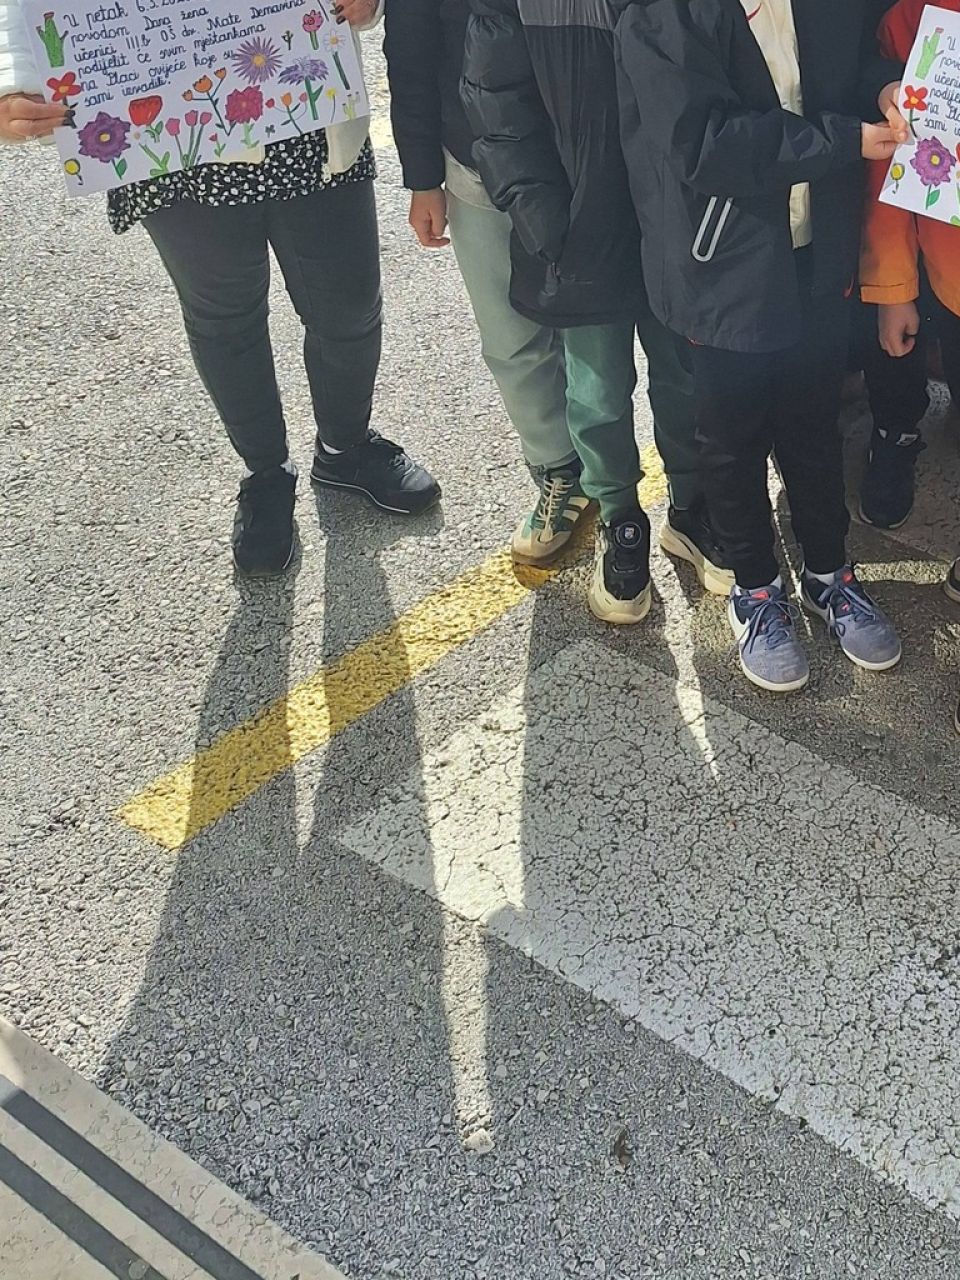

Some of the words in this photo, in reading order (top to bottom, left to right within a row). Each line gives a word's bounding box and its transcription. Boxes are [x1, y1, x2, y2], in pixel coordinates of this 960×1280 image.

[64, 14, 78, 27] U
[86, 2, 128, 31] petak
[71, 22, 130, 47] povodom
[145, 15, 171, 31] Dana
[181, 6, 209, 21] žena
[74, 42, 117, 63] učenici
[207, 10, 241, 31] Mate
[947, 36, 955, 51] U
[80, 78, 98, 92] na
[194, 52, 217, 67] koje
[84, 93, 114, 107] sami
[927, 101, 939, 114] na
[925, 117, 947, 131] sami
